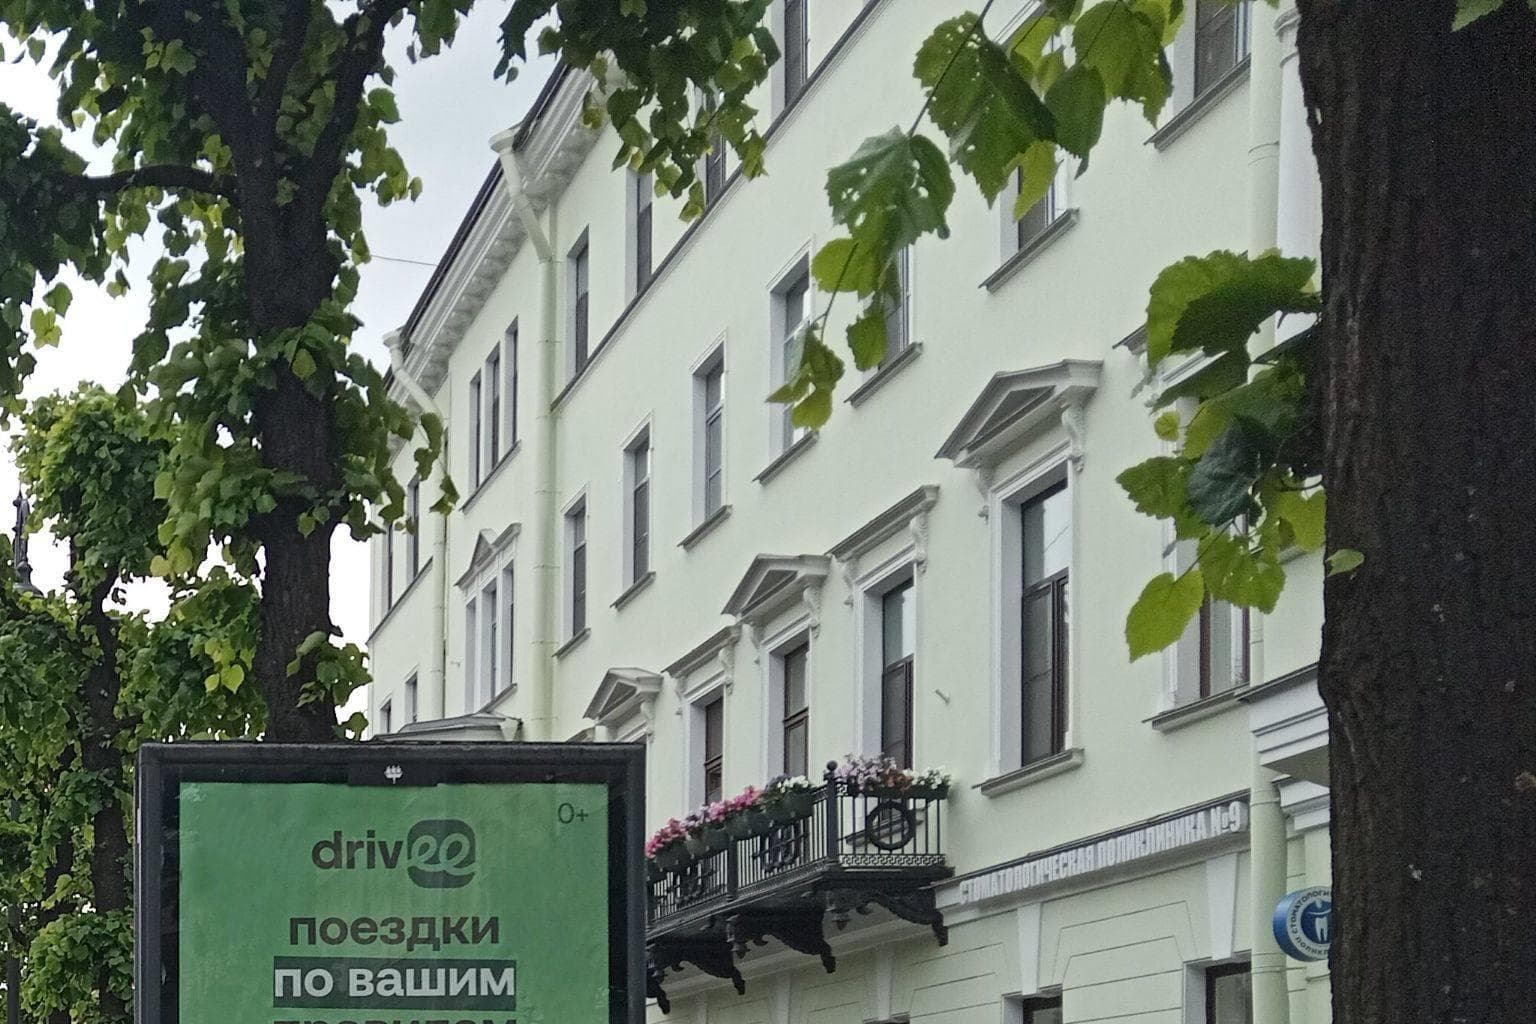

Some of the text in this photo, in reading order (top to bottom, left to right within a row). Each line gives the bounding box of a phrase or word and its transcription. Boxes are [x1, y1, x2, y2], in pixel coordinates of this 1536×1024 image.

[558, 803, 588, 824] 0+
[311, 822, 476, 882] drivee
[960, 844, 1094, 905] СТОМАТОЛОГИЧЕСКАЯ
[1097, 811, 1206, 871] ПОЛИКЛИНИКА
[1291, 889, 1330, 934] СТОМАТОЛОГИ
[289, 915, 500, 952] поездки
[274, 965, 515, 998] по вашим
